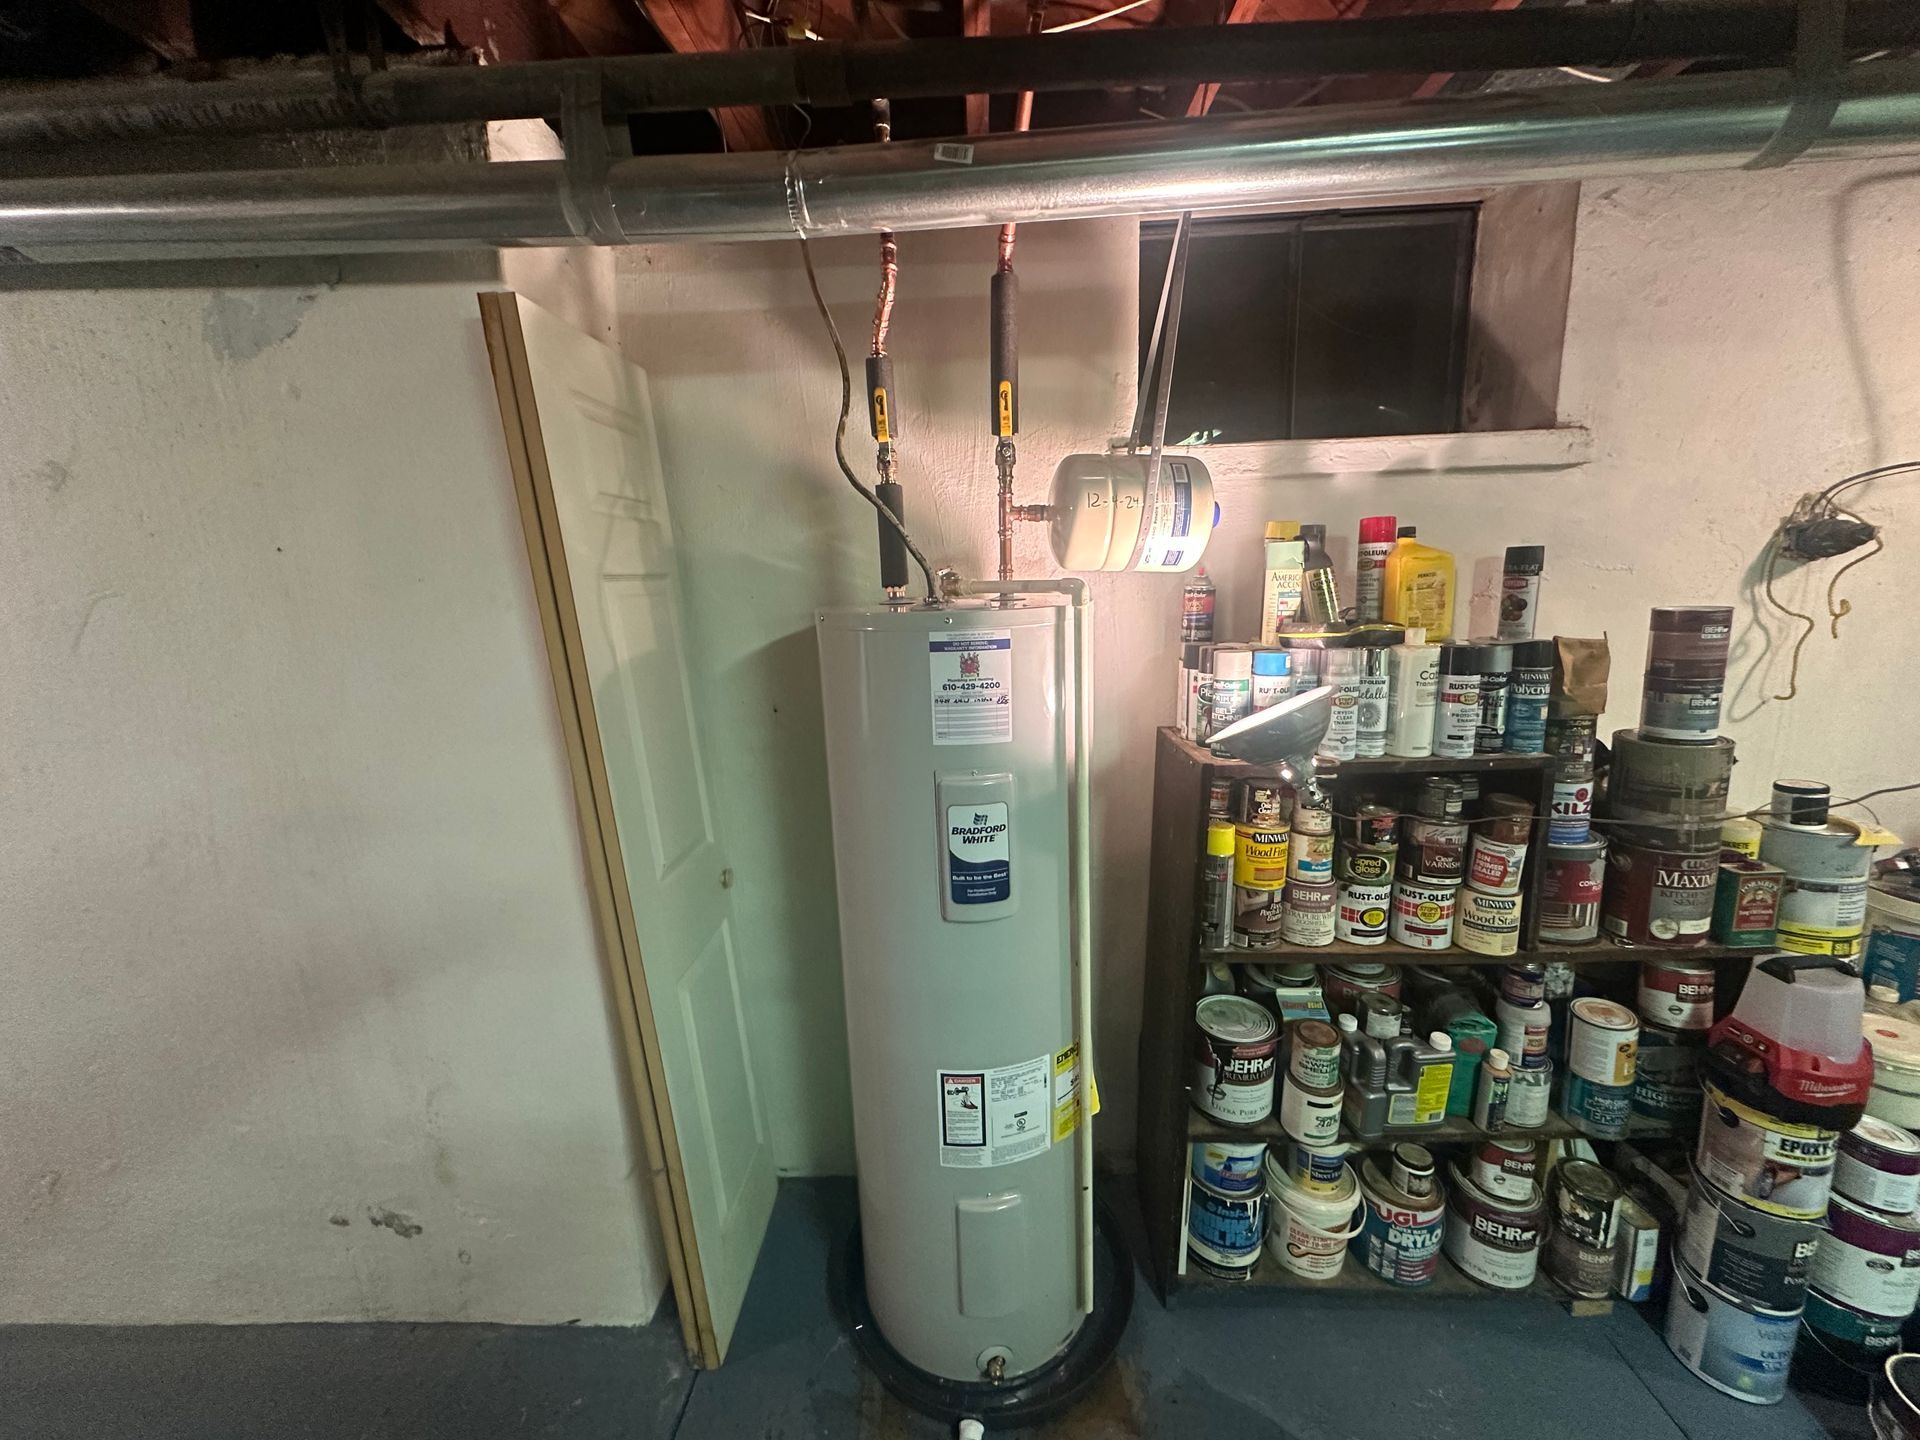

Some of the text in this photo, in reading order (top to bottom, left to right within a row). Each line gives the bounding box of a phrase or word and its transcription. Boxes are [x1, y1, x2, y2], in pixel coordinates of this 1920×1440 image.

[1087, 491, 1140, 509] 12-4-24
[942, 681, 1001, 692] 610-429-4200
[951, 823, 1007, 835] BRADFORD
[962, 834, 996, 844] WHITE
[1245, 844, 1271, 857] Wood
[1355, 866, 1380, 875] gloss
[1425, 860, 1461, 869] VARNISH
[1292, 889, 1321, 901] BEHR
[1476, 898, 1515, 910] MINWAX
[1463, 909, 1497, 925] Wood
[1678, 983, 1708, 995] BEHR
[1800, 1079, 1857, 1092] Milwaukee
[1504, 1159, 1532, 1170] BEHR
[1376, 1201, 1432, 1227] UGL
[1475, 1215, 1521, 1241] BEHR
[1578, 1251, 1607, 1264] BEHR
